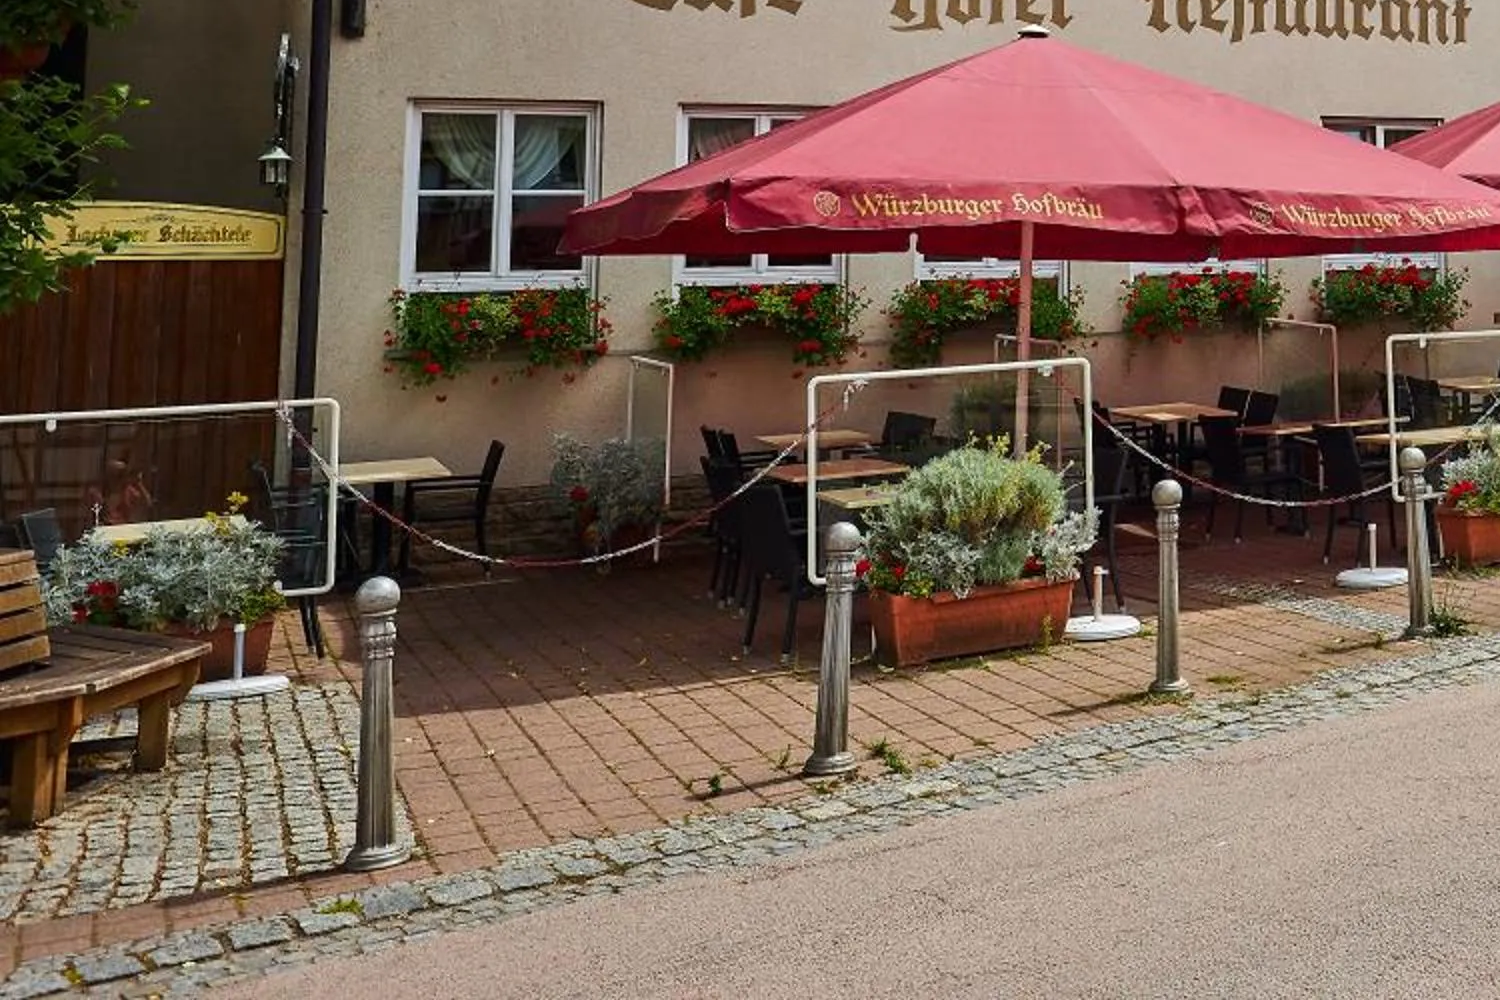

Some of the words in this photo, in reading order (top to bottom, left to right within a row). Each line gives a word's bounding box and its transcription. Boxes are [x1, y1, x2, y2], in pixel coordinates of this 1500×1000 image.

[851, 190, 1003, 221] Würzburger
[1011, 191, 1105, 220] Hofbräu
[1279, 202, 1402, 233] Würzburger
[1407, 206, 1490, 228] Hofbräu
